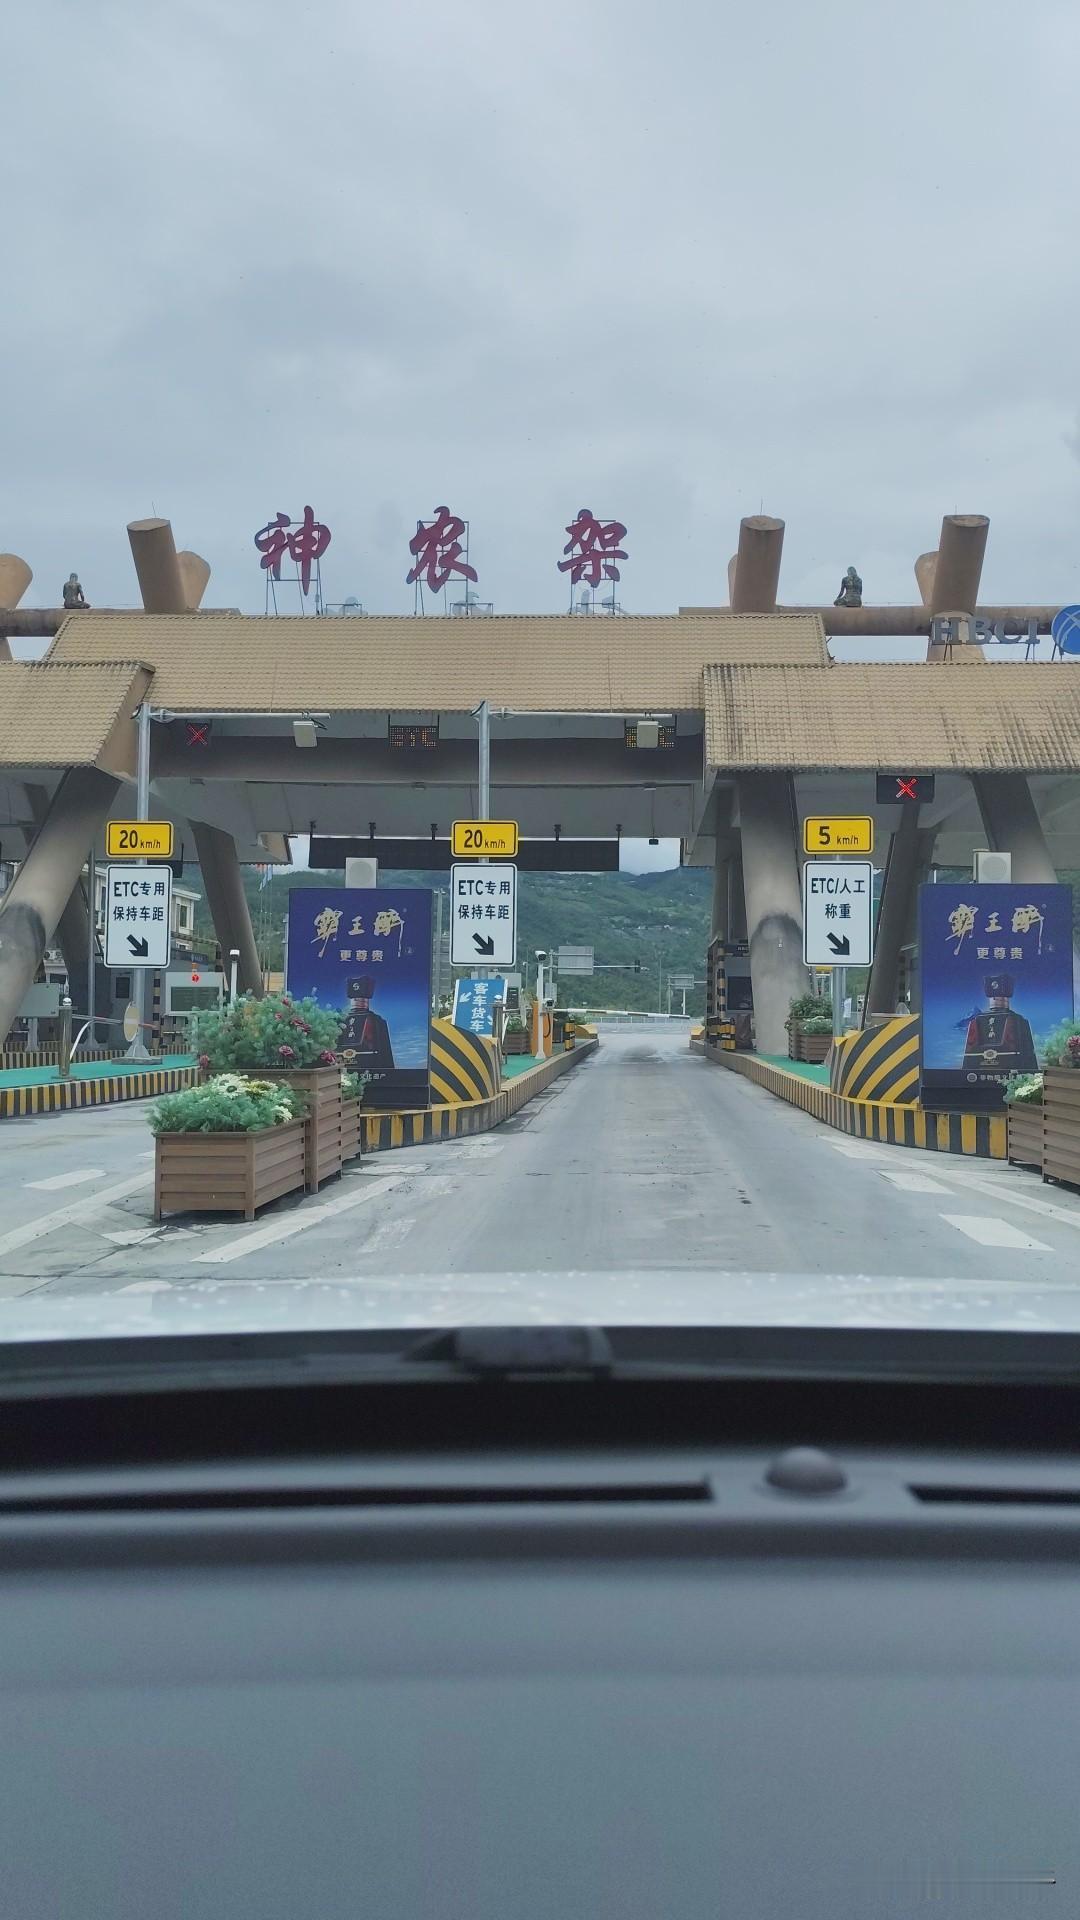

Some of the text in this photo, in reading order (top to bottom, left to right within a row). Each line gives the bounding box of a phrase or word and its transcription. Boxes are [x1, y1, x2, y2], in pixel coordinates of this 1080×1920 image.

[254, 505, 630, 597] 神农架
[389, 727, 438, 748] ETC
[119, 829, 161, 849] 20 km/h
[463, 829, 506, 849] 20 km/h
[818, 825, 859, 846] 5 km/h
[113, 881, 165, 897] ETC专用
[458, 879, 511, 896] ETC专用
[811, 877, 865, 894] ETC/人工
[113, 906, 164, 921] 保持车距
[458, 904, 510, 920] 保持车距
[824, 903, 852, 919] 称重
[339, 949, 384, 962] 更尊贵
[976, 947, 1024, 960] 更尊贵
[469, 982, 489, 1032] 客车货车
